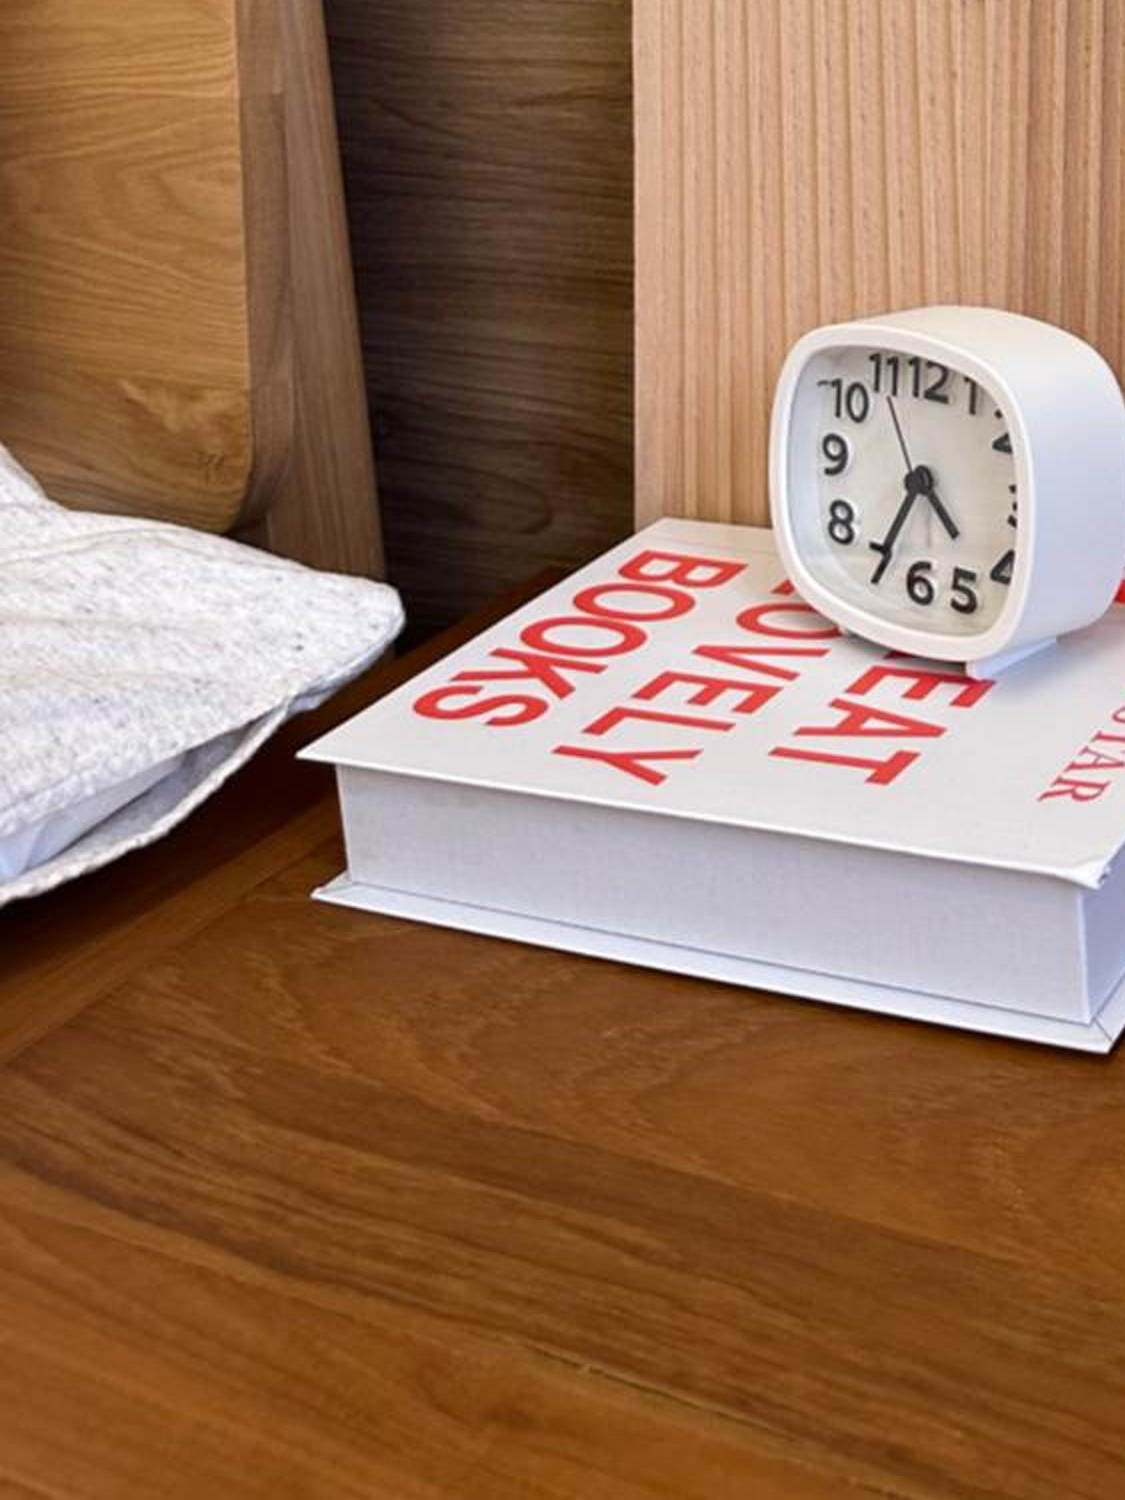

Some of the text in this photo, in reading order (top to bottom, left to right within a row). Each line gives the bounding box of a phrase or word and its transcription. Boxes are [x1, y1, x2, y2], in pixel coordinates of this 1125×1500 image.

[869, 353, 899, 397] 11
[908, 357, 950, 404] 12
[817, 378, 870, 424] 10
[822, 433, 848, 476] 9
[828, 499, 855, 545] 8
[907, 561, 935, 606] 6
[950, 567, 978, 614] 5
[413, 550, 748, 727] BOOKS
[551, 579, 843, 786] OVELY
[769, 653, 996, 785] EAT
